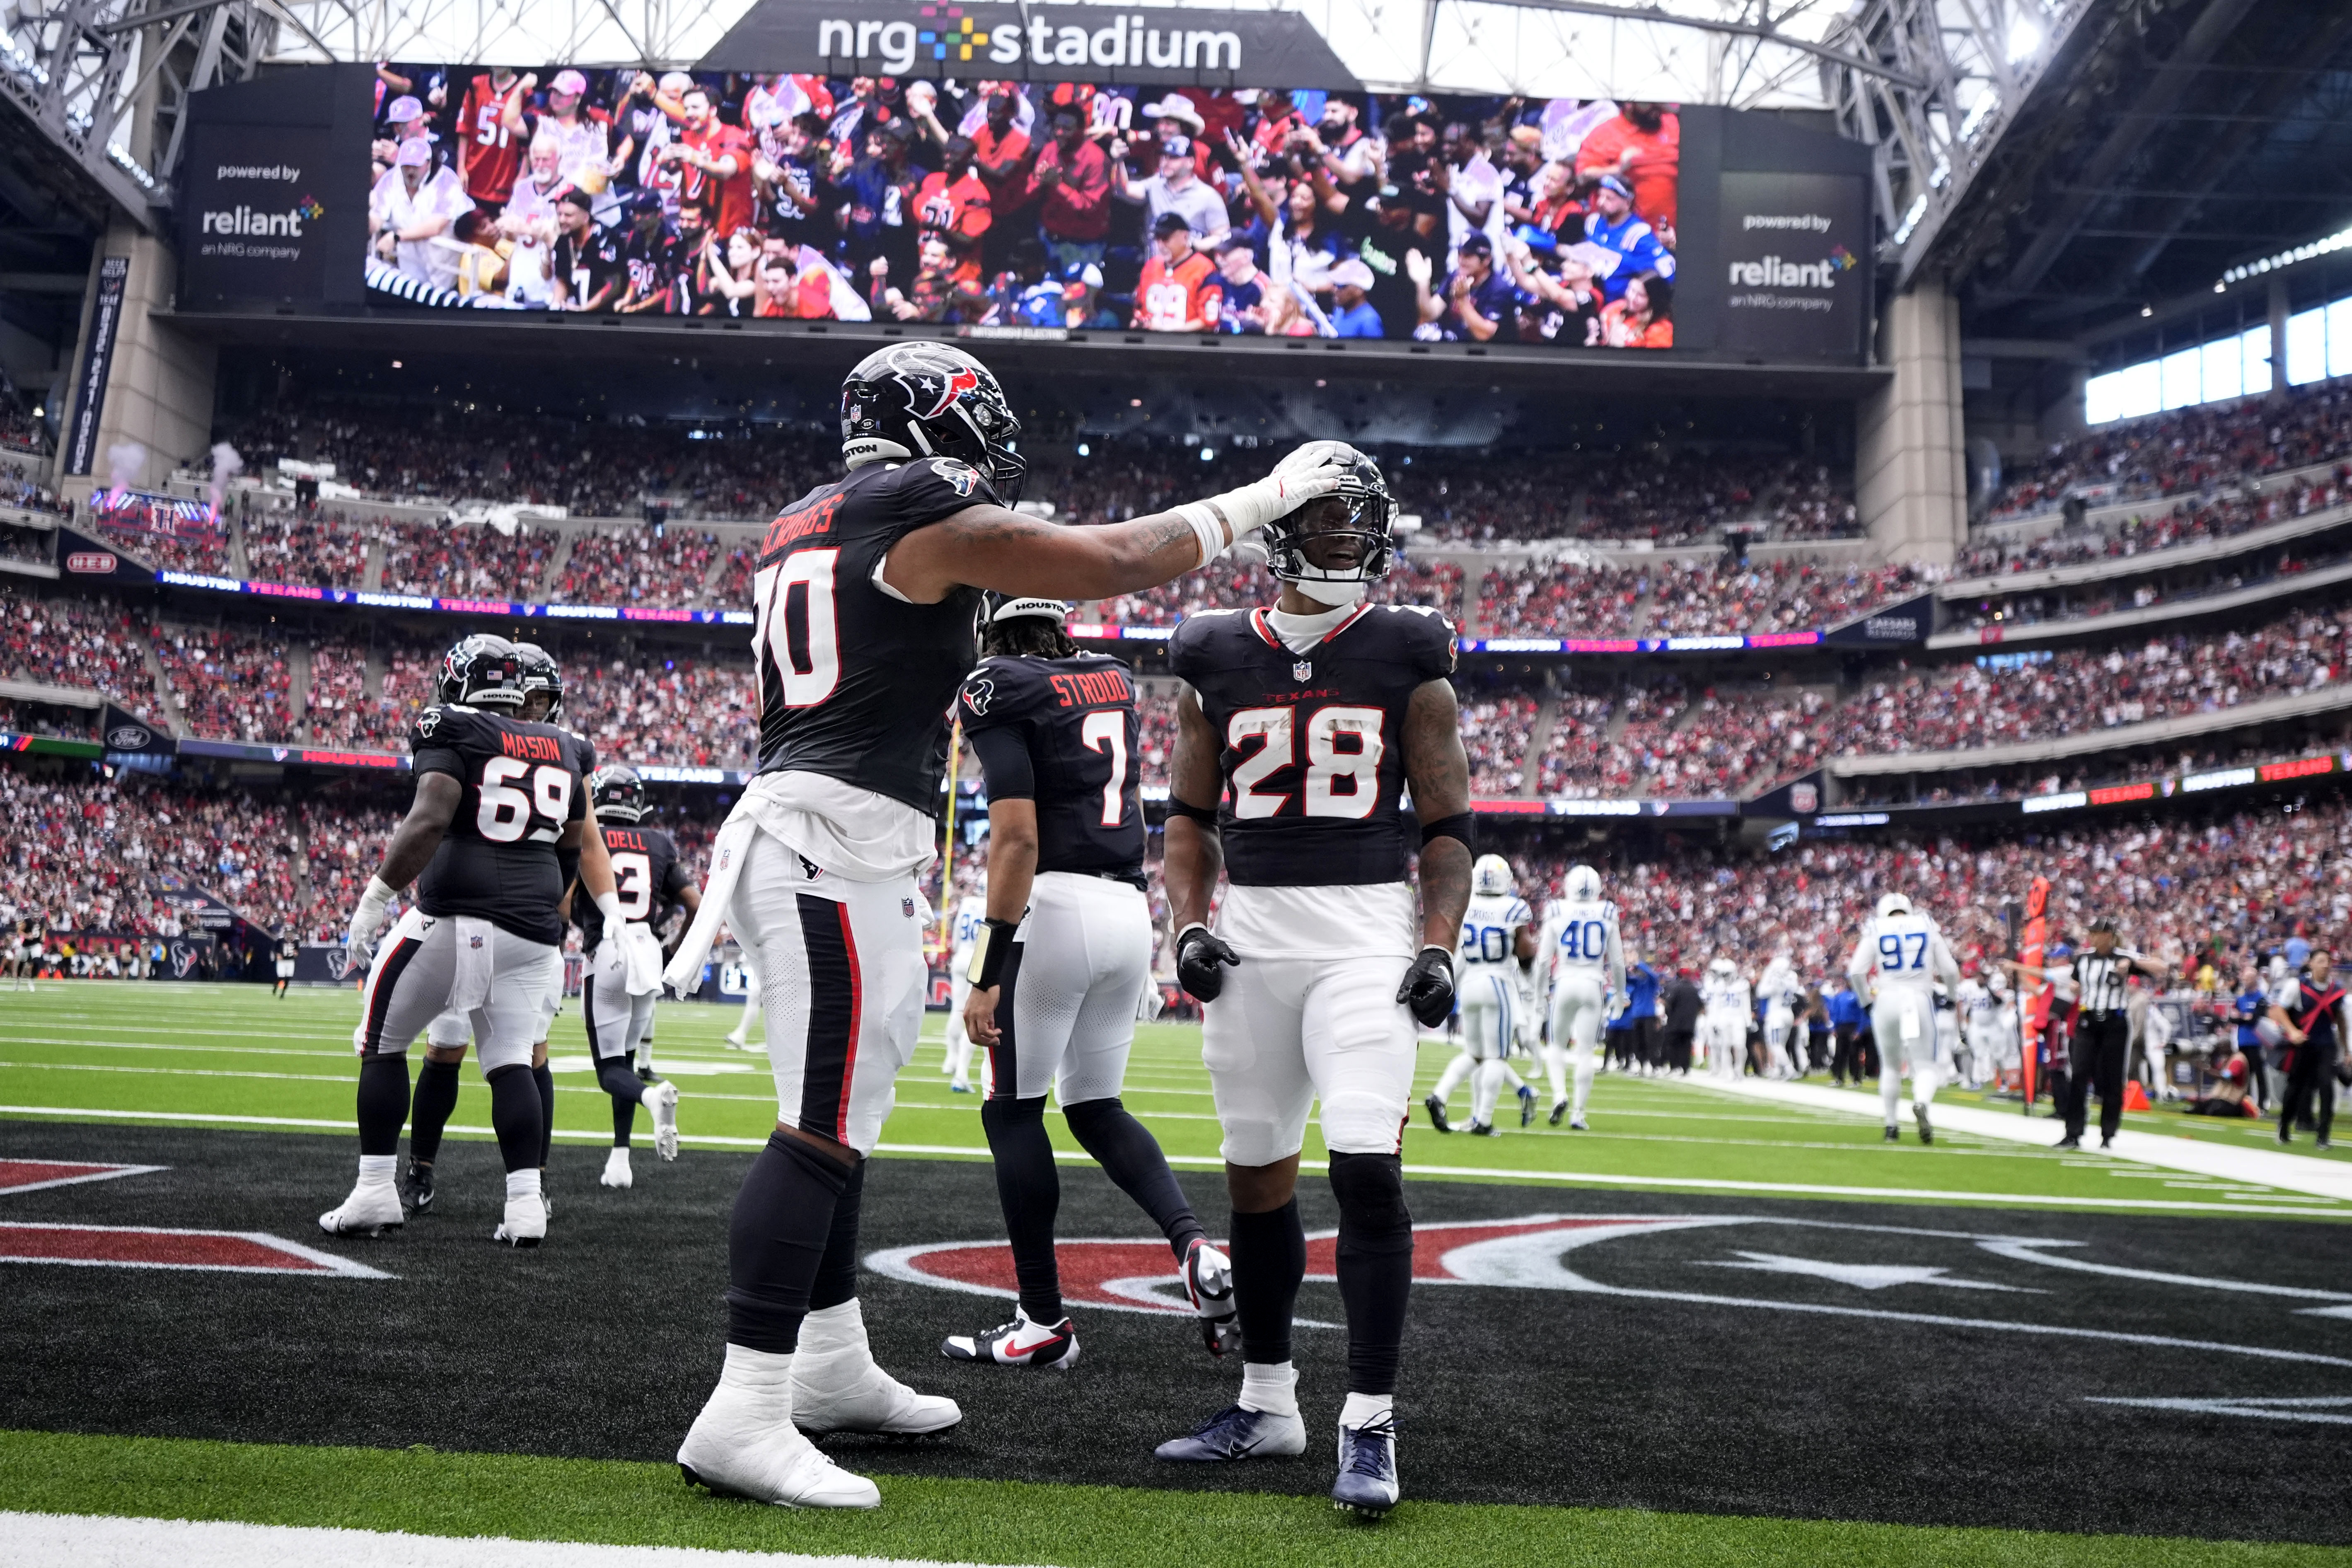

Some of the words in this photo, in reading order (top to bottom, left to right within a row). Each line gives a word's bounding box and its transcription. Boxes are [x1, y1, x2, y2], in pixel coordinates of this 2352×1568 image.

[819, 19, 916, 75] nrg
[989, 17, 1242, 69] stadium
[217, 164, 280, 180] powered
[282, 164, 300, 183] by
[203, 205, 303, 237] reliant
[1743, 214, 1811, 232] powered
[1811, 214, 1831, 234] by
[201, 244, 216, 255] an
[217, 242, 245, 257] NRG
[247, 246, 301, 261] company
[1728, 255, 1836, 289] reliant
[1777, 297, 1834, 313] company
[844, 445, 877, 459] STON
[162, 571, 241, 592] HOUSTON
[248, 581, 322, 599] TEXANS
[357, 592, 432, 609] HOUSTON
[439, 598, 510, 614] TEXANS
[546, 605, 618, 619] HOUSTON
[624, 608, 691, 621] TEXANS
[1015, 602, 1065, 614] HOUSTON
[751, 546, 841, 716] 70
[1049, 670, 1129, 707] STROUD
[1262, 688, 1340, 703] TEXANS
[302, 750, 397, 767] HOUSTON
[501, 731, 561, 761] MASON
[1081, 709, 1128, 826] 7
[1228, 704, 1386, 819] 28
[2260, 756, 2333, 781] TEXANS
[636, 766, 724, 783] TEXANS
[476, 756, 573, 843] 69
[2089, 783, 2153, 805] TEXANS
[1551, 801, 1641, 815] TEXANS
[606, 830, 647, 851] DELL
[610, 852, 652, 920] 3
[1463, 923, 1506, 963] 20
[1560, 921, 1607, 959] 40
[1879, 933, 1928, 970] 97
